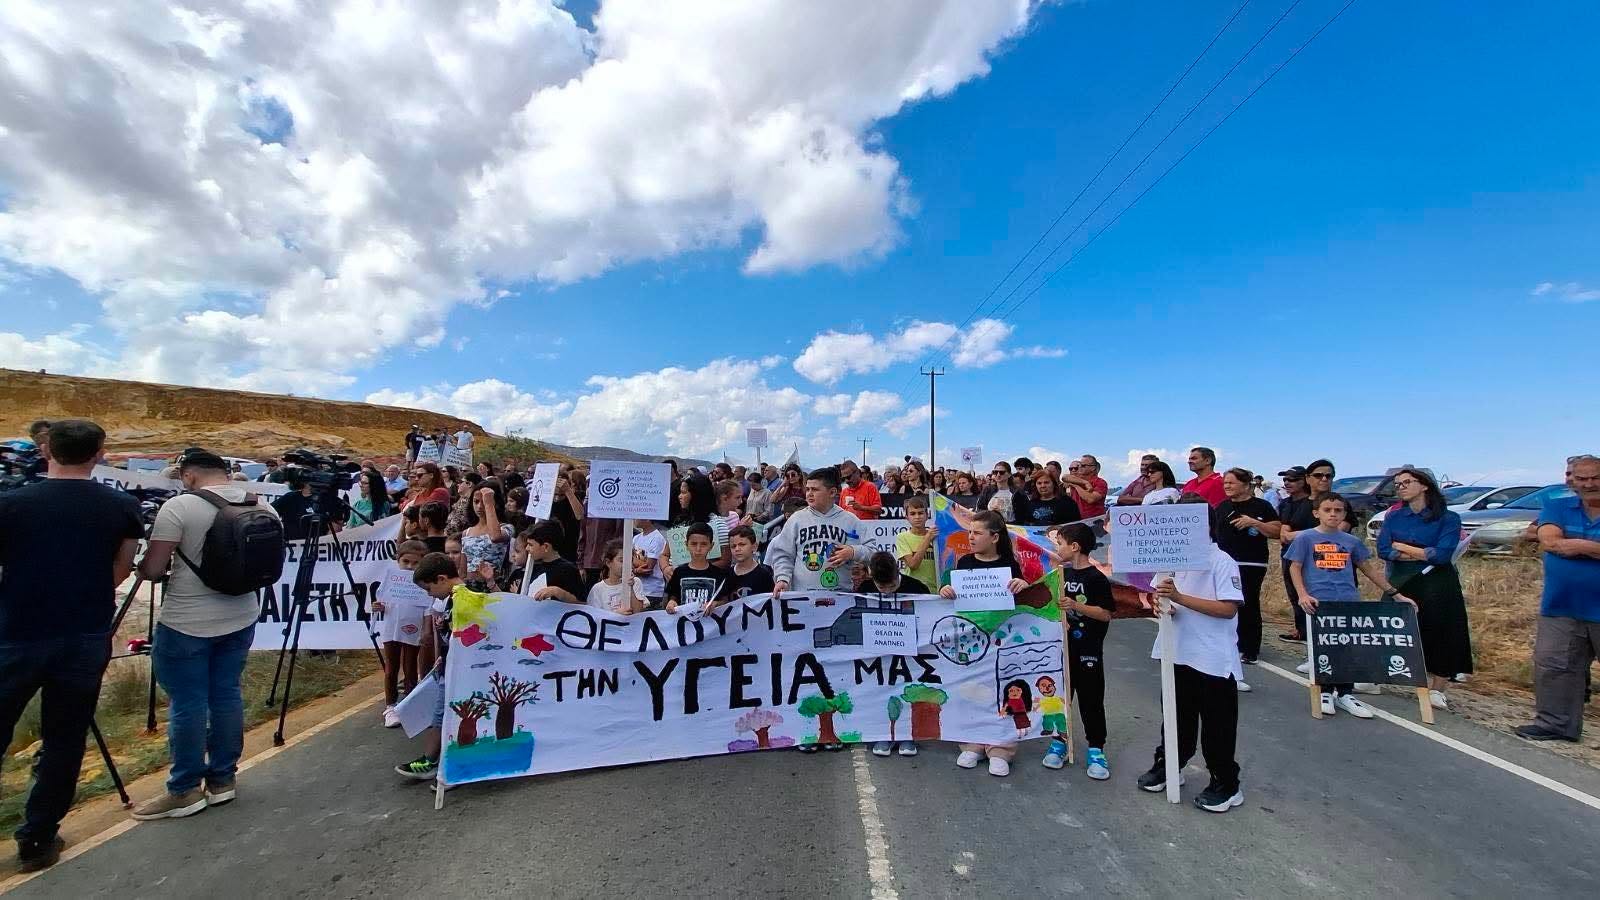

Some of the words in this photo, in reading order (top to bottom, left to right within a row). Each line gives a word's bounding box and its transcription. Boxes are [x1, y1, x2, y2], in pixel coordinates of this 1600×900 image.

[1119, 513, 1146, 526] ΟΧΙ
[1148, 516, 1200, 524] ΑΣΦΑΛΤΙΚΟ
[1128, 528, 1146, 537] ΣΤΟ
[1148, 528, 1189, 536] ΜΙΤΣΕΡΟ
[364, 539, 398, 560] ΡΥΠΟ
[1064, 581, 1085, 594] ASA
[556, 597, 810, 651] ΘΕΛΟΥΜΕ
[1351, 616, 1374, 628] ΝΑ
[1378, 616, 1405, 628] ΤΟ
[543, 668, 619, 702] ΤΗΝ
[633, 652, 835, 721] ΥΓΕΙΑ
[854, 654, 942, 685] ΜΑΣ
